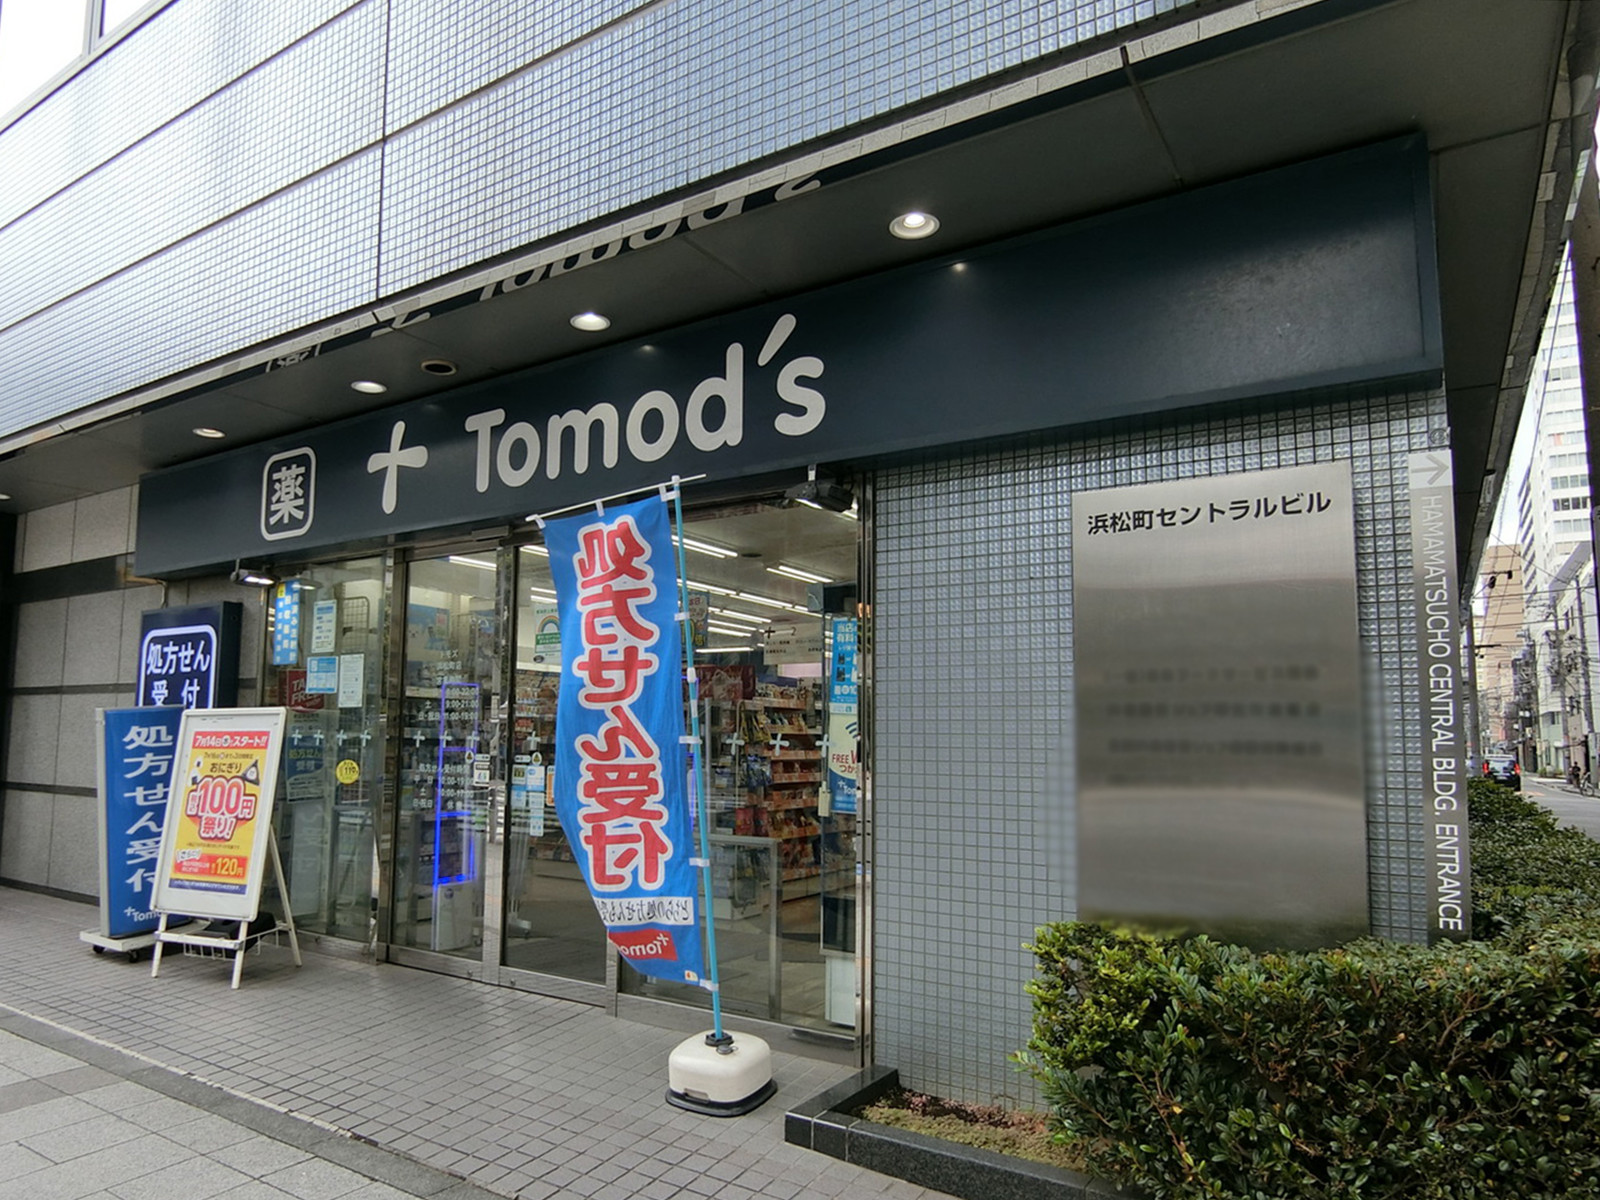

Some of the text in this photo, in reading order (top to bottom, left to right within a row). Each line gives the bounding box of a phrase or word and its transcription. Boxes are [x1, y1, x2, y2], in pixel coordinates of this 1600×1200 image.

[464, 313, 826, 492] Tomod's
[269, 464, 305, 524] 薬
[1087, 491, 1332, 535] 浜松町セントラルビル
[146, 640, 210, 674] 処方せん
[1421, 495, 1463, 931] HAMAMATSUCHO CENTRAL BLDG. ENTRANCE
[210, 762, 242, 773] おにぎり
[832, 753, 849, 764] FREE
